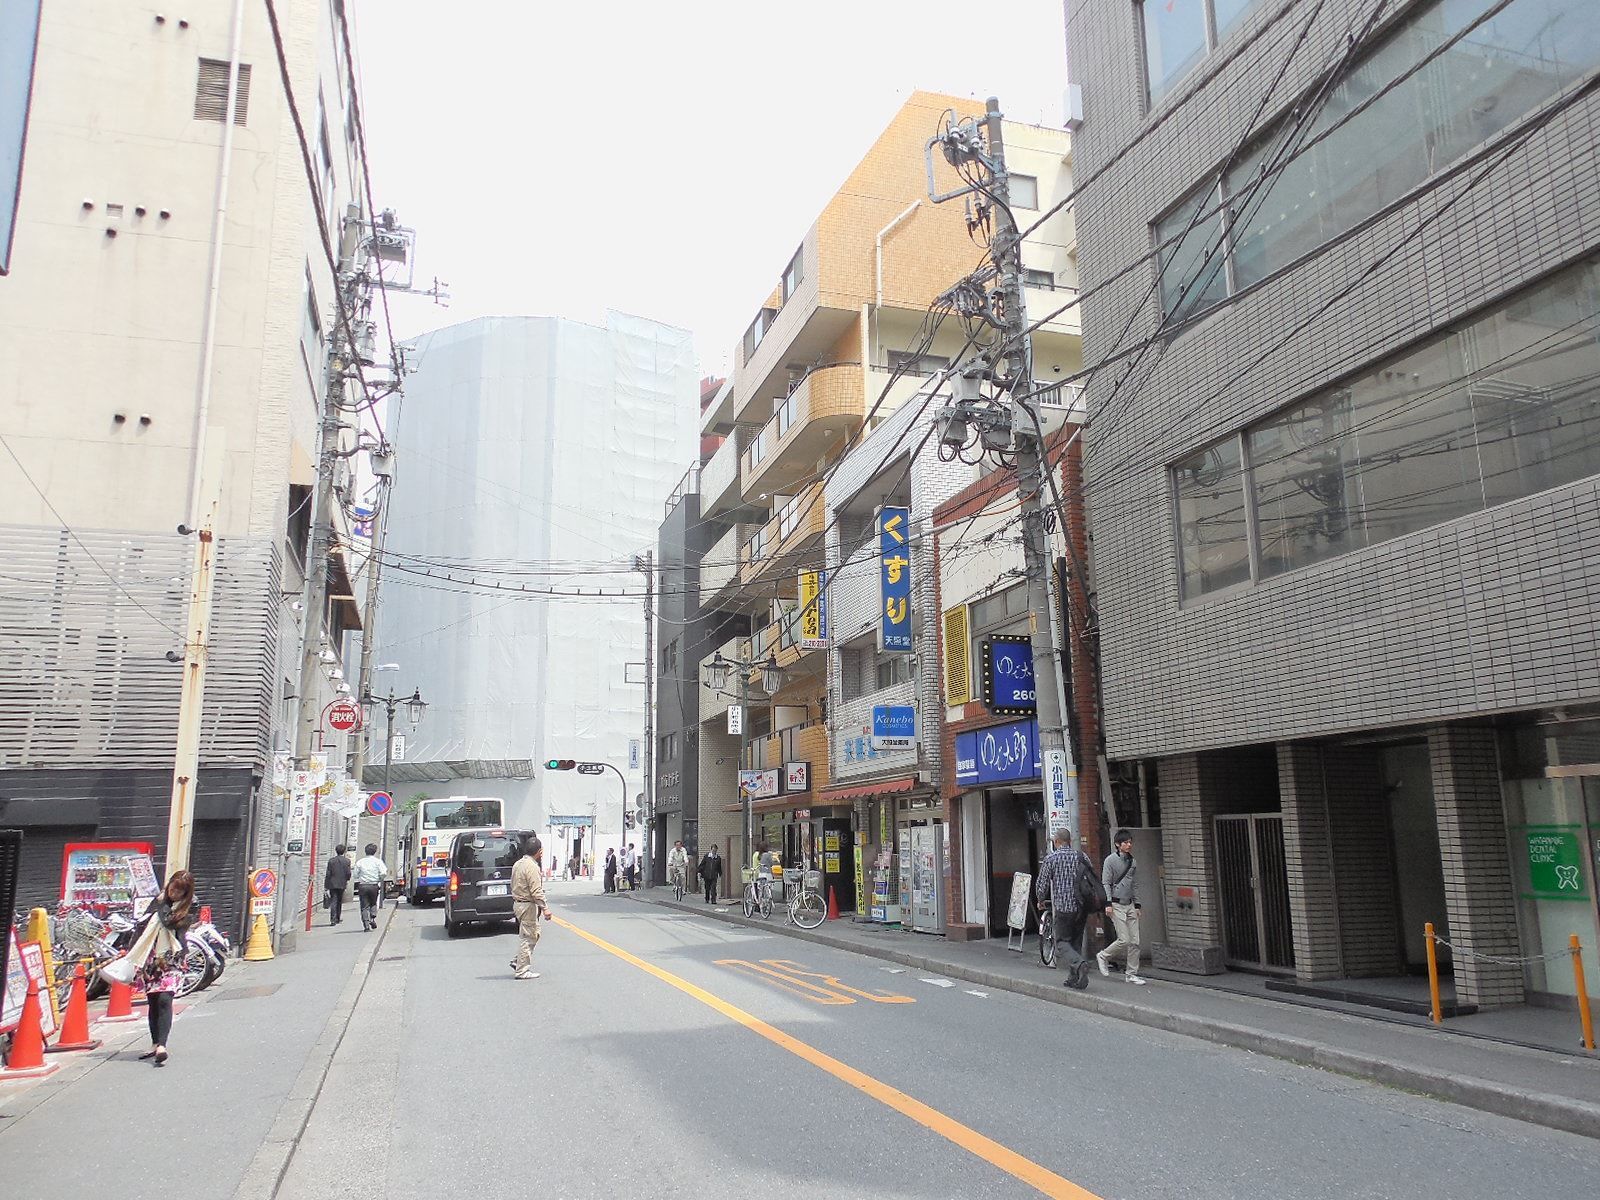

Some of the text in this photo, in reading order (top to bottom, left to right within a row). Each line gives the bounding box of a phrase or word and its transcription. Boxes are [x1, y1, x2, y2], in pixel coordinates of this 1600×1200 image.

[883, 514, 909, 625] くすり
[331, 712, 355, 723] 消火栓
[875, 714, 914, 724] Kanebo
[1052, 765, 1065, 809] 小川町歯科
[1529, 845, 1557, 854] DENTAL
[1531, 854, 1555, 863] CLINIC
